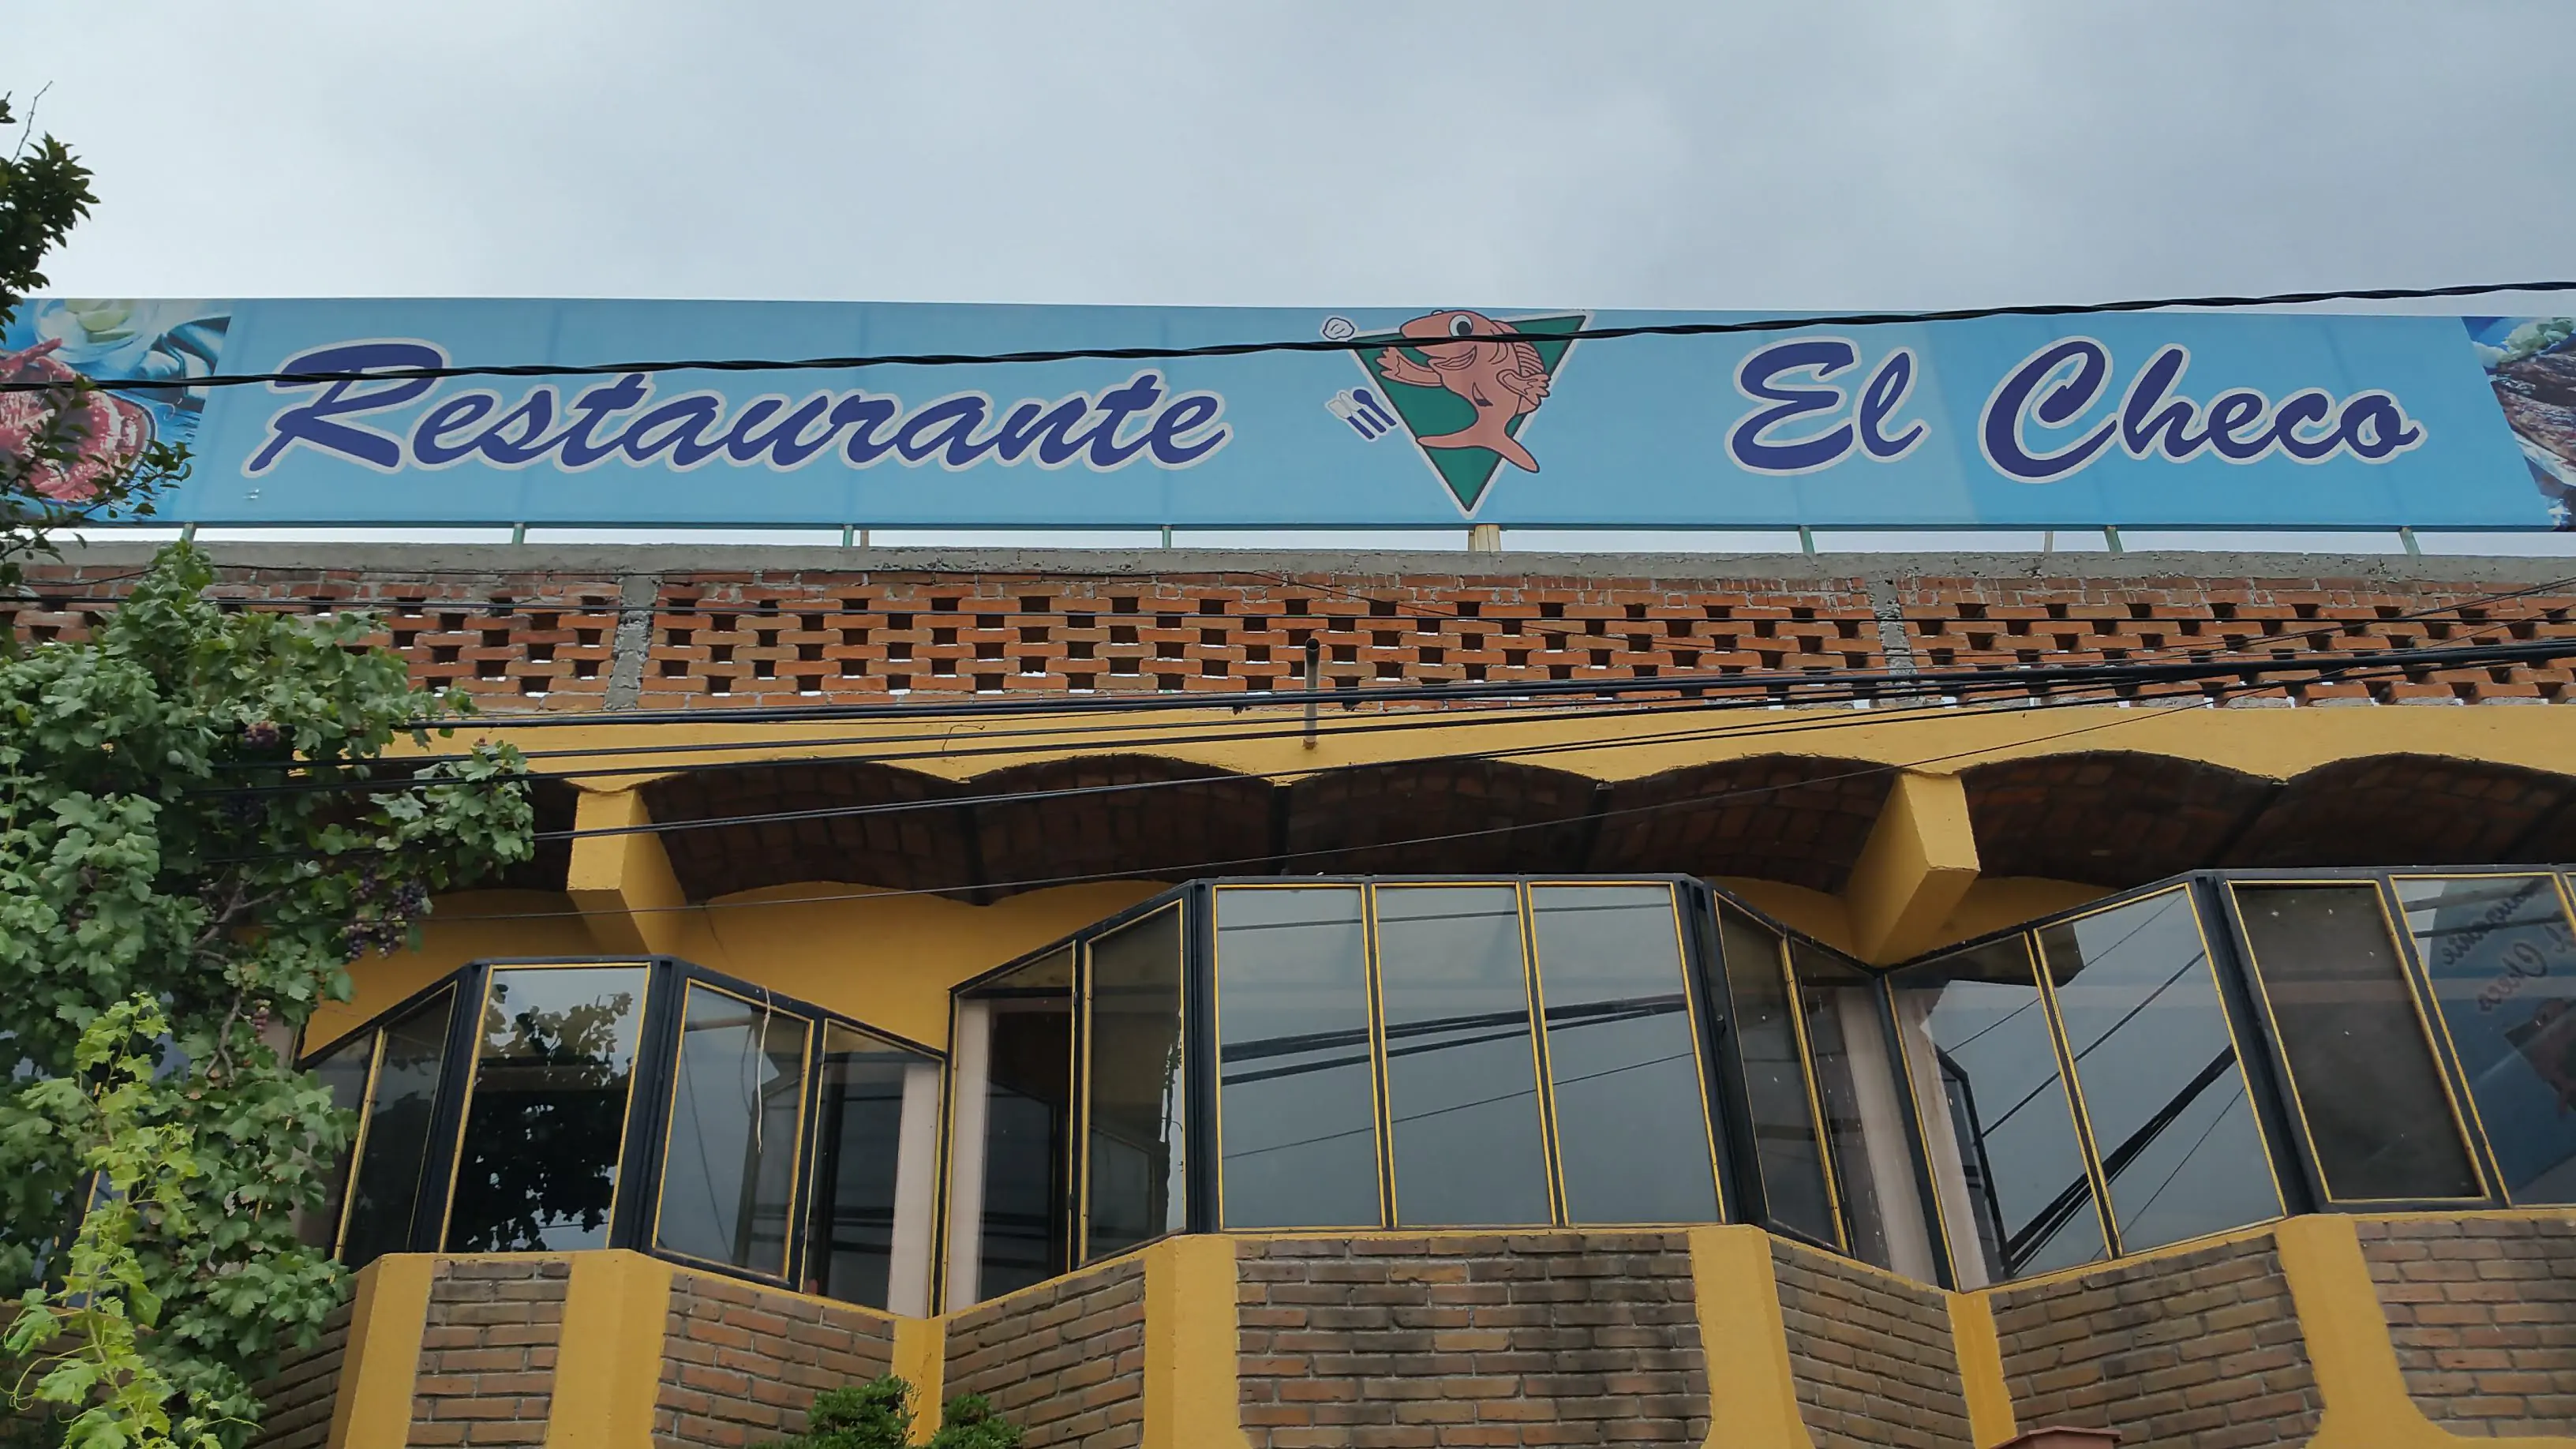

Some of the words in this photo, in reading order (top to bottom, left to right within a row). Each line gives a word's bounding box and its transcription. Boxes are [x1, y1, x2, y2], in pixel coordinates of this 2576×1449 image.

[247, 338, 1226, 474] Restaurante
[1729, 339, 1926, 474] El
[1983, 340, 2423, 480] Checo
